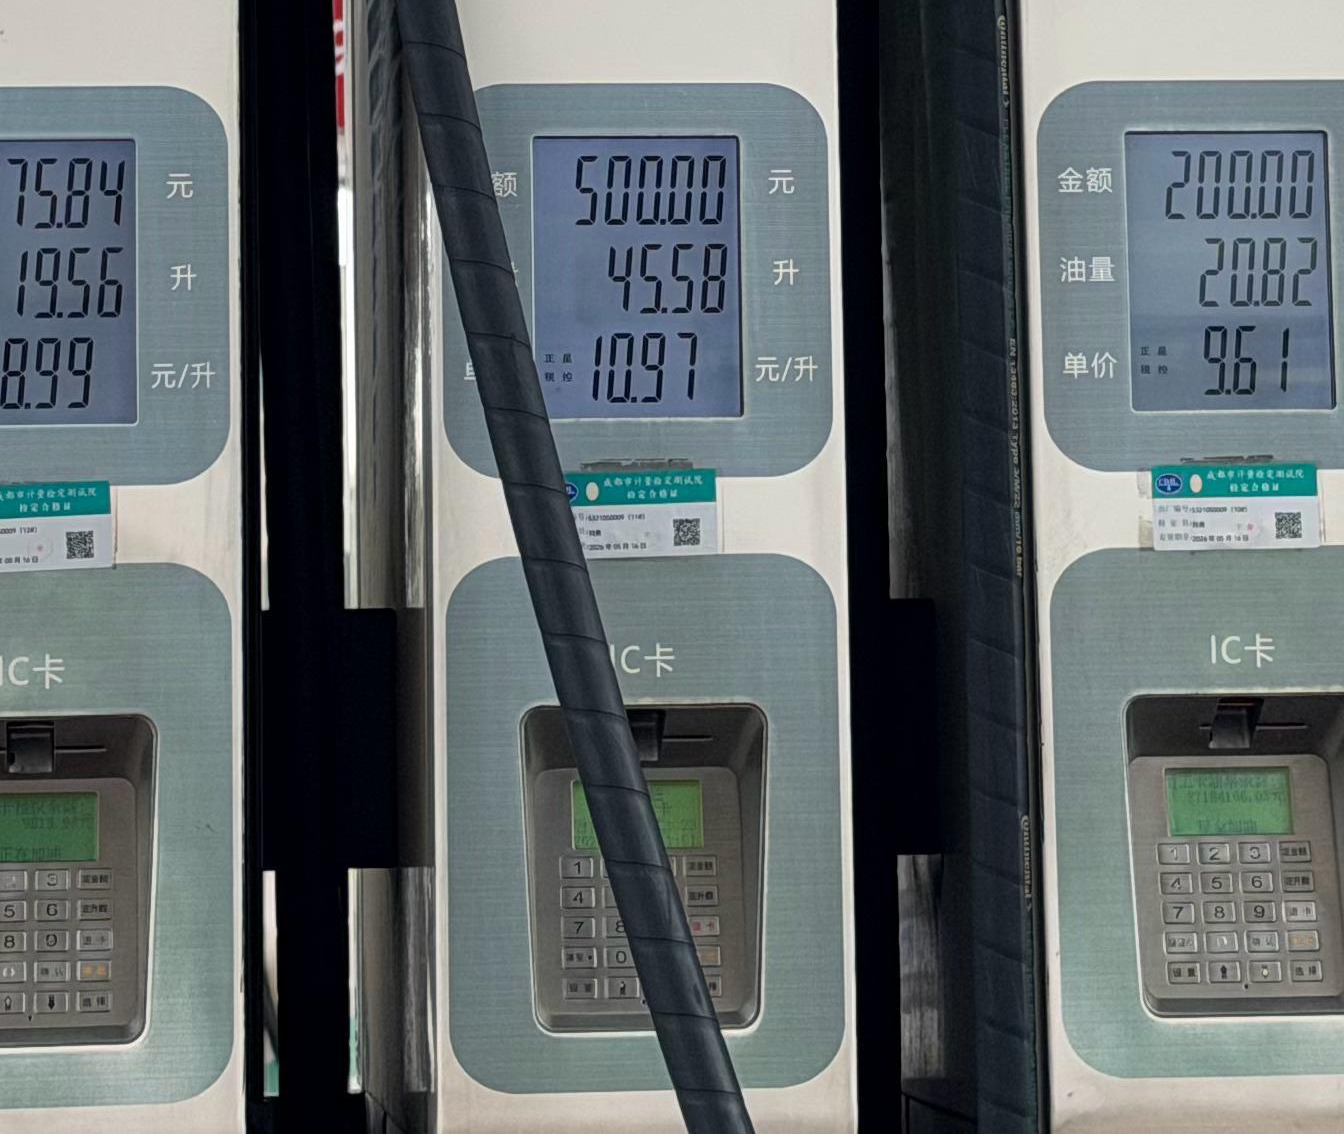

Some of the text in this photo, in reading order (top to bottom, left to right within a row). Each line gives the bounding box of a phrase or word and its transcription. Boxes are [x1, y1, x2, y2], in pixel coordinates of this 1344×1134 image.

[165, 173, 194, 199] 元
[490, 171, 518, 198] 额
[575, 155, 728, 226] 500.00
[767, 169, 795, 196] 元
[1057, 167, 1113, 194] 金额
[1165, 150, 1315, 220] 200.00
[15, 247, 125, 318] 19.56
[169, 264, 197, 291] 升
[607, 243, 728, 314] 45.58
[772, 259, 800, 286] 升
[1060, 257, 1116, 283] 油量
[1199, 237, 1318, 307] 20.82
[0, 337, 94, 409] 8.99
[591, 332, 698, 403] 10.97
[755, 356, 818, 383] 元/升
[1062, 353, 1118, 380] 单价
[1203, 325, 1291, 396] 9.61
[150, 361, 216, 389] 元/升
[1210, 633, 1276, 668] IC卡
[1208, 847, 1220, 861] 2
[1249, 846, 1261, 859] 3
[47, 873, 58, 886] 3
[573, 861, 581, 874] 1
[1170, 877, 1181, 890] 4
[1211, 876, 1223, 889] 5
[1251, 875, 1263, 888] 6
[3, 905, 15, 918] 5
[46, 903, 58, 916] 6
[572, 891, 583, 904] 4
[1172, 905, 1184, 919] 7
[1213, 905, 1225, 919] 8
[1253, 904, 1265, 918] 9
[573, 921, 584, 934] 7
[3, 935, 15, 949] 8
[615, 950, 627, 963] 0
